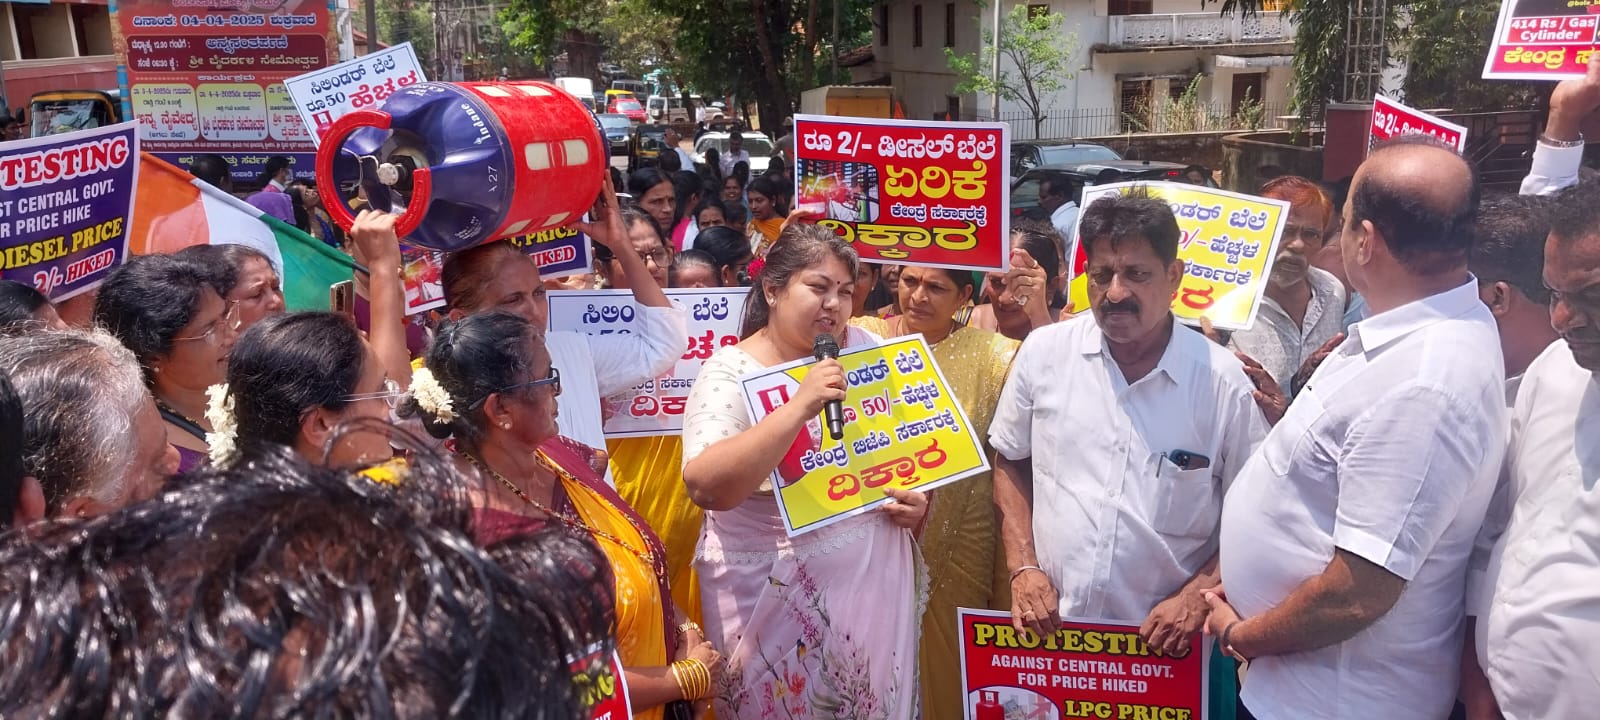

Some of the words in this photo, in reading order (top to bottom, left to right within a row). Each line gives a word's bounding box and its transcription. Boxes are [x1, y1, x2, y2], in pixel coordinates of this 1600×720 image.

[181, 14, 265, 27] 04-04-2025
[1511, 18, 1537, 29] 414
[1540, 18, 1557, 28] Rs
[1559, 17, 1566, 30] /
[1569, 17, 1596, 28] Gas
[1520, 29, 1581, 42] Cylinder
[1503, 46, 1566, 69] ಕೇಂದ್ರ
[310, 64, 366, 95] ಸಿಲಿಂಡರ್
[373, 55, 395, 74] ಬೆಲೆ
[461, 103, 491, 144] Indane
[804, 129, 832, 151] ರೂ
[837, 131, 872, 157] 2/-
[878, 132, 953, 159] ಡೀಸಲ್
[956, 133, 996, 160] ಬೆಲೆ
[0, 139, 129, 188] TESTING
[884, 159, 987, 200] ಏರಿಕೆ
[17, 187, 79, 214] CENTRAL
[83, 178, 115, 199] GOVT.
[16, 211, 59, 236] PRICE
[63, 204, 91, 225] HIKE
[891, 202, 927, 221] ಕೇಂದ್ರ
[931, 203, 987, 227] ಸರ್ಕಾರಕ್ಕೆ
[1229, 209, 1267, 231] ಬೆಲೆ
[71, 217, 123, 253] PRICE
[525, 225, 578, 246] PRICE
[1210, 235, 1259, 264] ಹೆಚ್ಚಳ
[65, 248, 115, 284] HIKED
[693, 296, 729, 321] ಬೆಲೆ
[847, 359, 890, 386] ಂಡರ್
[895, 350, 924, 374] ಬೆಲೆ
[901, 380, 939, 410] ಹೆಚ್ಚಳ
[800, 442, 848, 472] ಕೇಂದ್ರ
[853, 431, 891, 456] ಬಿಜೆಪಿ
[895, 409, 959, 441] ಸರ್ಕಾರಕ್ಕೆ
[991, 654, 1053, 671] AGAINST
[1058, 658, 1126, 676] CENTRAL
[1131, 663, 1174, 679] GOVT.
[1017, 672, 1047, 687] FOR
[1052, 675, 1097, 690] PRICE
[1102, 678, 1148, 694] HIKED
[1065, 699, 1112, 719] LPG
[1117, 703, 1191, 720] PRICE
